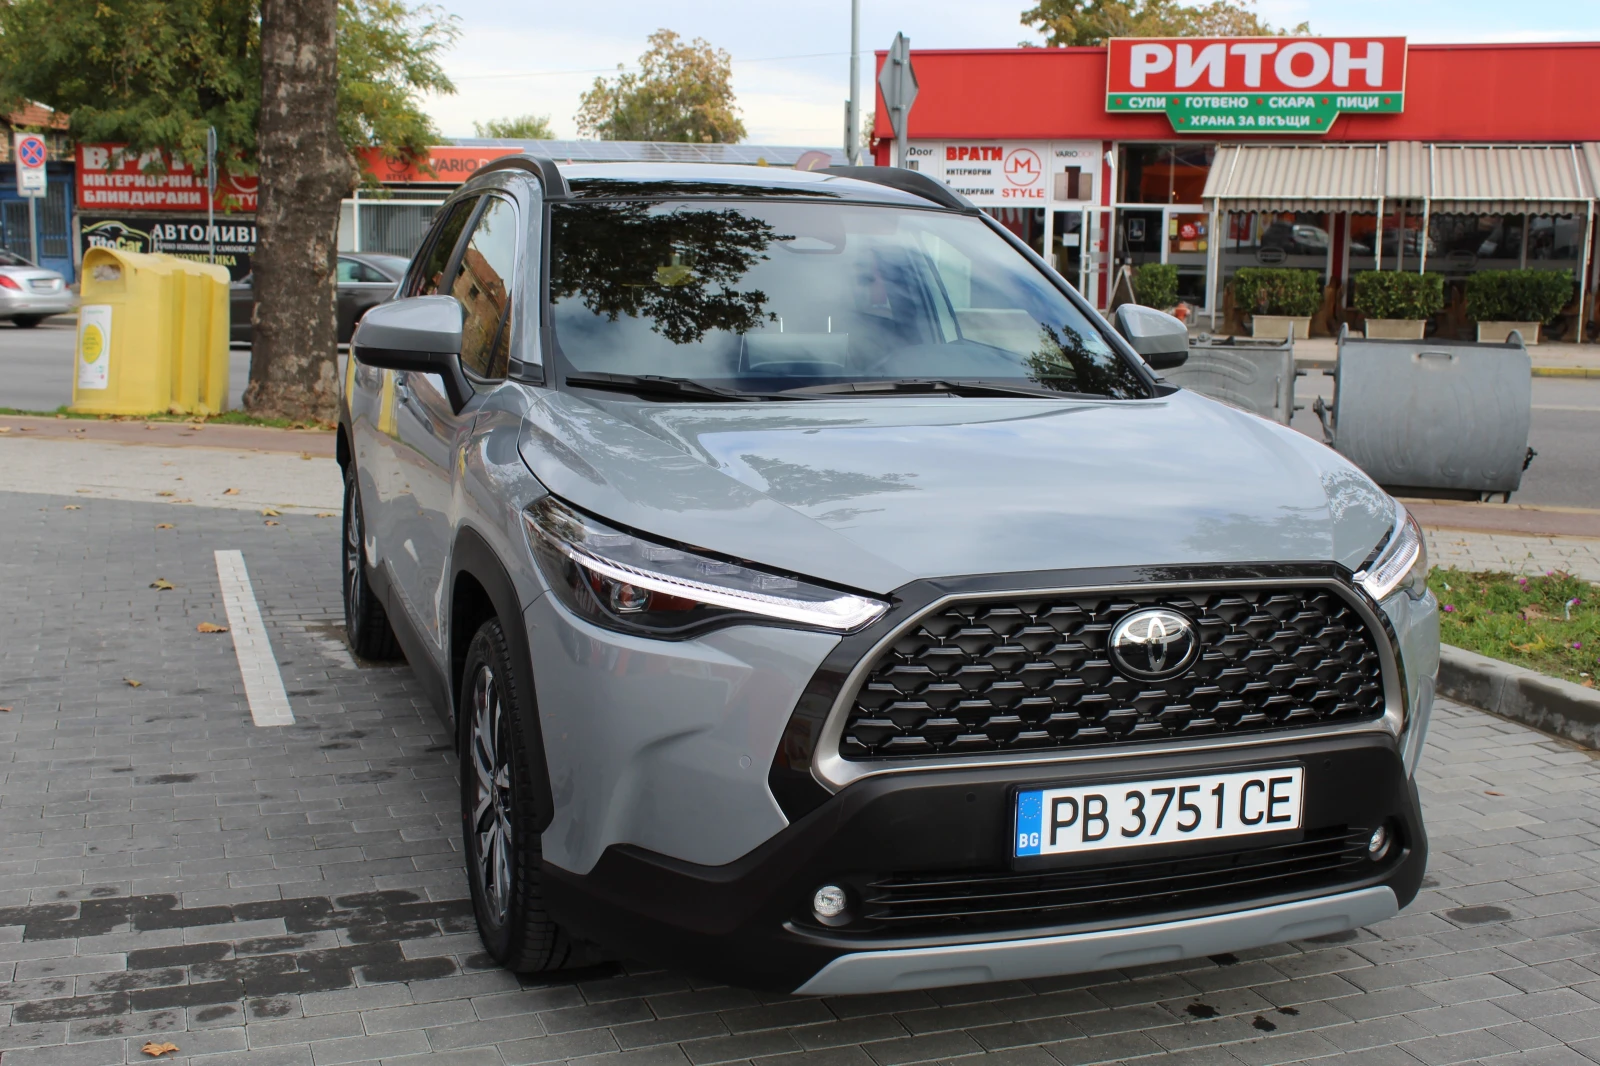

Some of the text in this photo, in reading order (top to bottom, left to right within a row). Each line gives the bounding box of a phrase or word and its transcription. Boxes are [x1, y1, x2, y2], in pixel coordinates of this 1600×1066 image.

[1130, 42, 1384, 88] РИТОН
[1129, 96, 1379, 109] СУПИ ГОТВЕНО СКАРА ПИЦИ
[1190, 115, 1310, 128] ХРАНА ЗА ВКЪЩИ
[946, 146, 1003, 161] ВРАТИ
[946, 168, 992, 176] ИНТЕРИОРНИ
[83, 174, 192, 188] ИНТЕРИОРНИ
[83, 190, 201, 205] БЛИНДИРАНИ
[1002, 188, 1045, 198] STYLE
[1050, 776, 1293, 845] PB 3751 CE
[1019, 832, 1039, 848] BG
